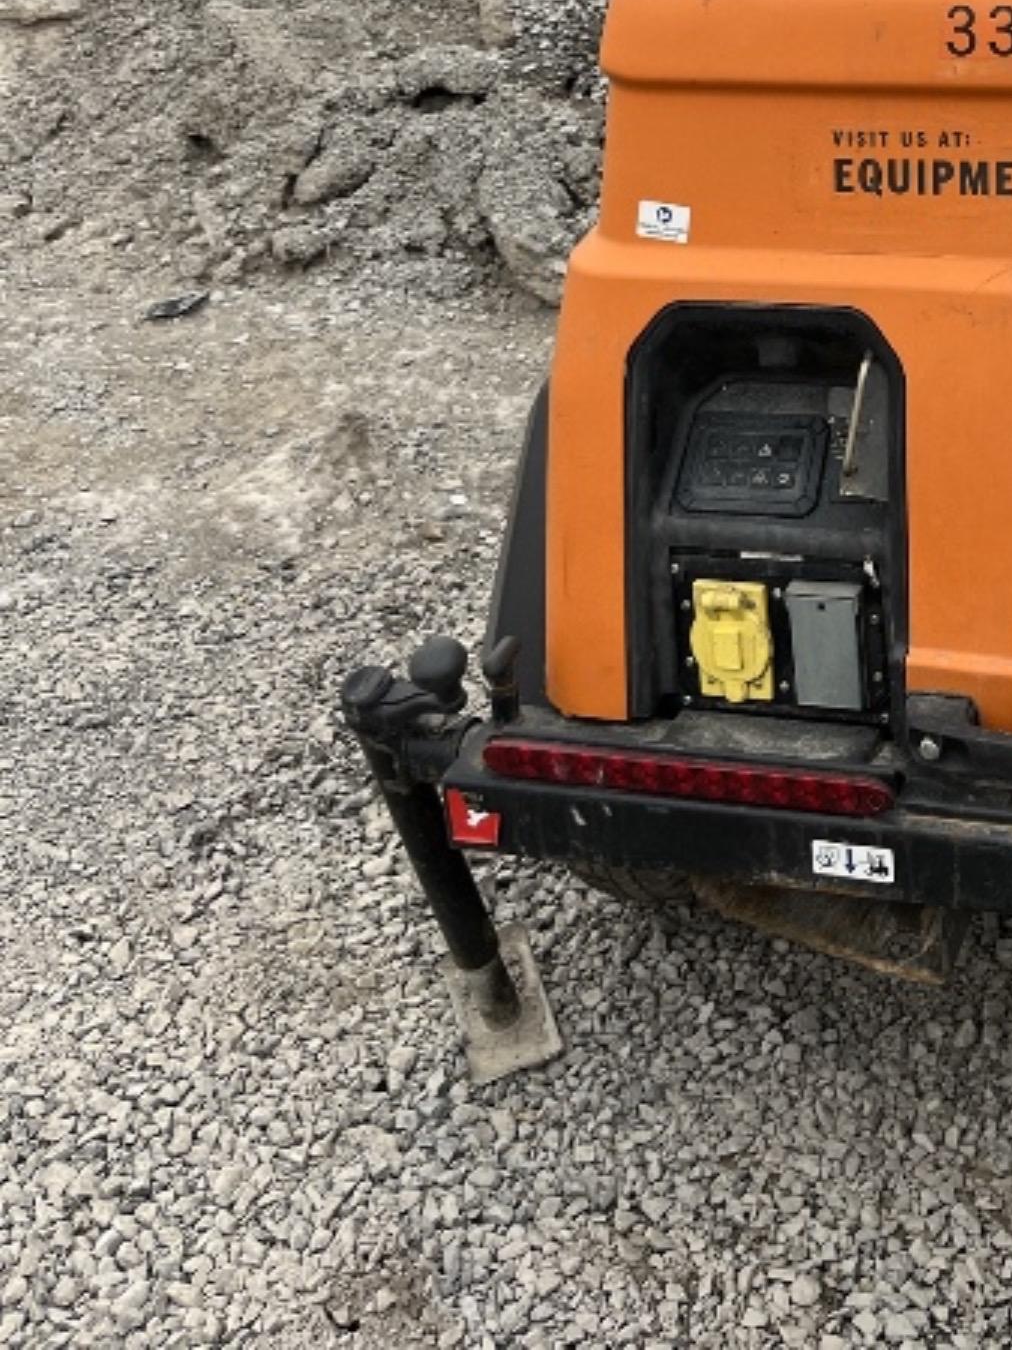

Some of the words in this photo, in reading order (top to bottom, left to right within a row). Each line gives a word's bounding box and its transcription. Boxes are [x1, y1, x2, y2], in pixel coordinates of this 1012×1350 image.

[832, 130, 889, 148] VISIT
[901, 131, 928, 148] US
[938, 131, 972, 148] AT:
